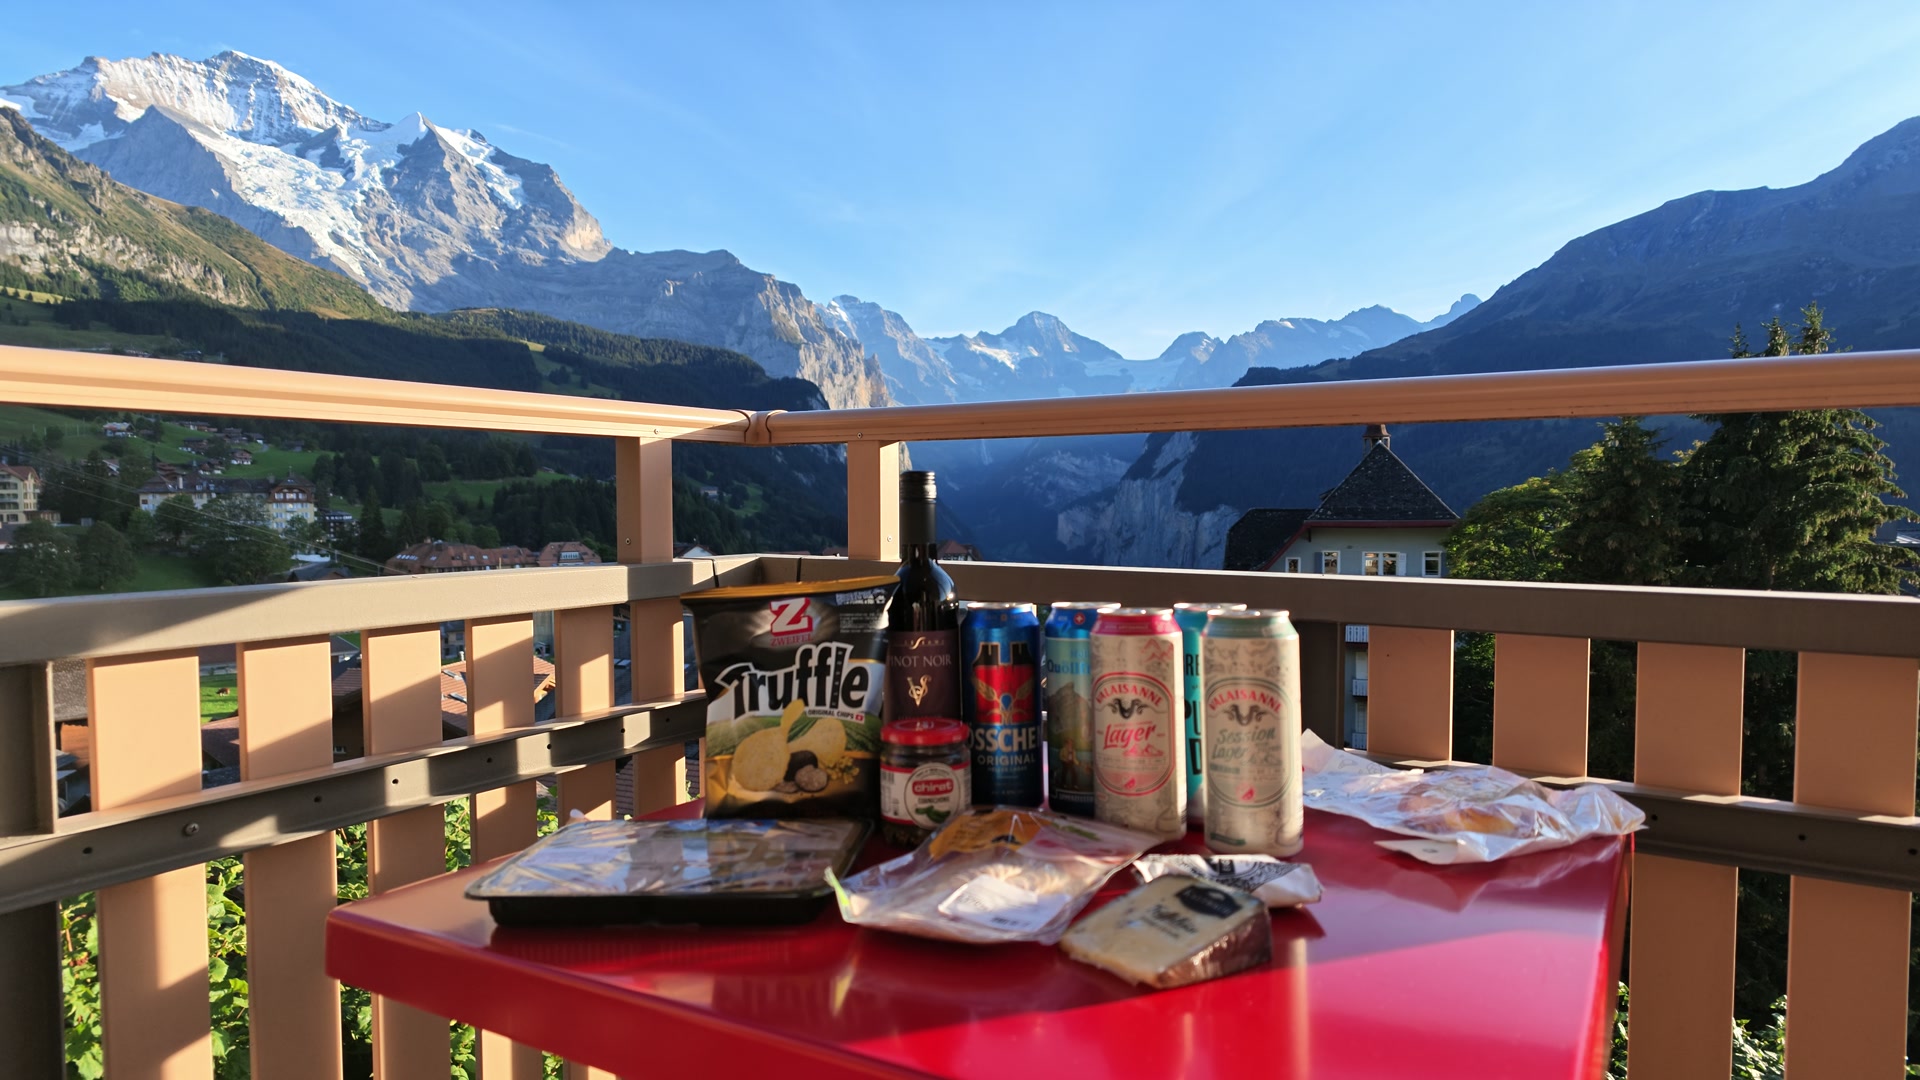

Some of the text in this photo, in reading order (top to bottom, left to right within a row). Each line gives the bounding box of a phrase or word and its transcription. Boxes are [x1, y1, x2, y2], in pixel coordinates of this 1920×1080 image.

[770, 597, 813, 636] Z
[771, 633, 813, 647] ZWEIFEL
[923, 653, 952, 668] NOIR
[715, 642, 870, 719] Truffle
[808, 709, 854, 720] ORIGINAL CHIPS
[1103, 723, 1156, 749] Lager
[1216, 725, 1276, 745] Session
[977, 753, 1036, 765] ORIGINAL
[1211, 743, 1248, 761] Lager
[914, 782, 953, 793] chirat
